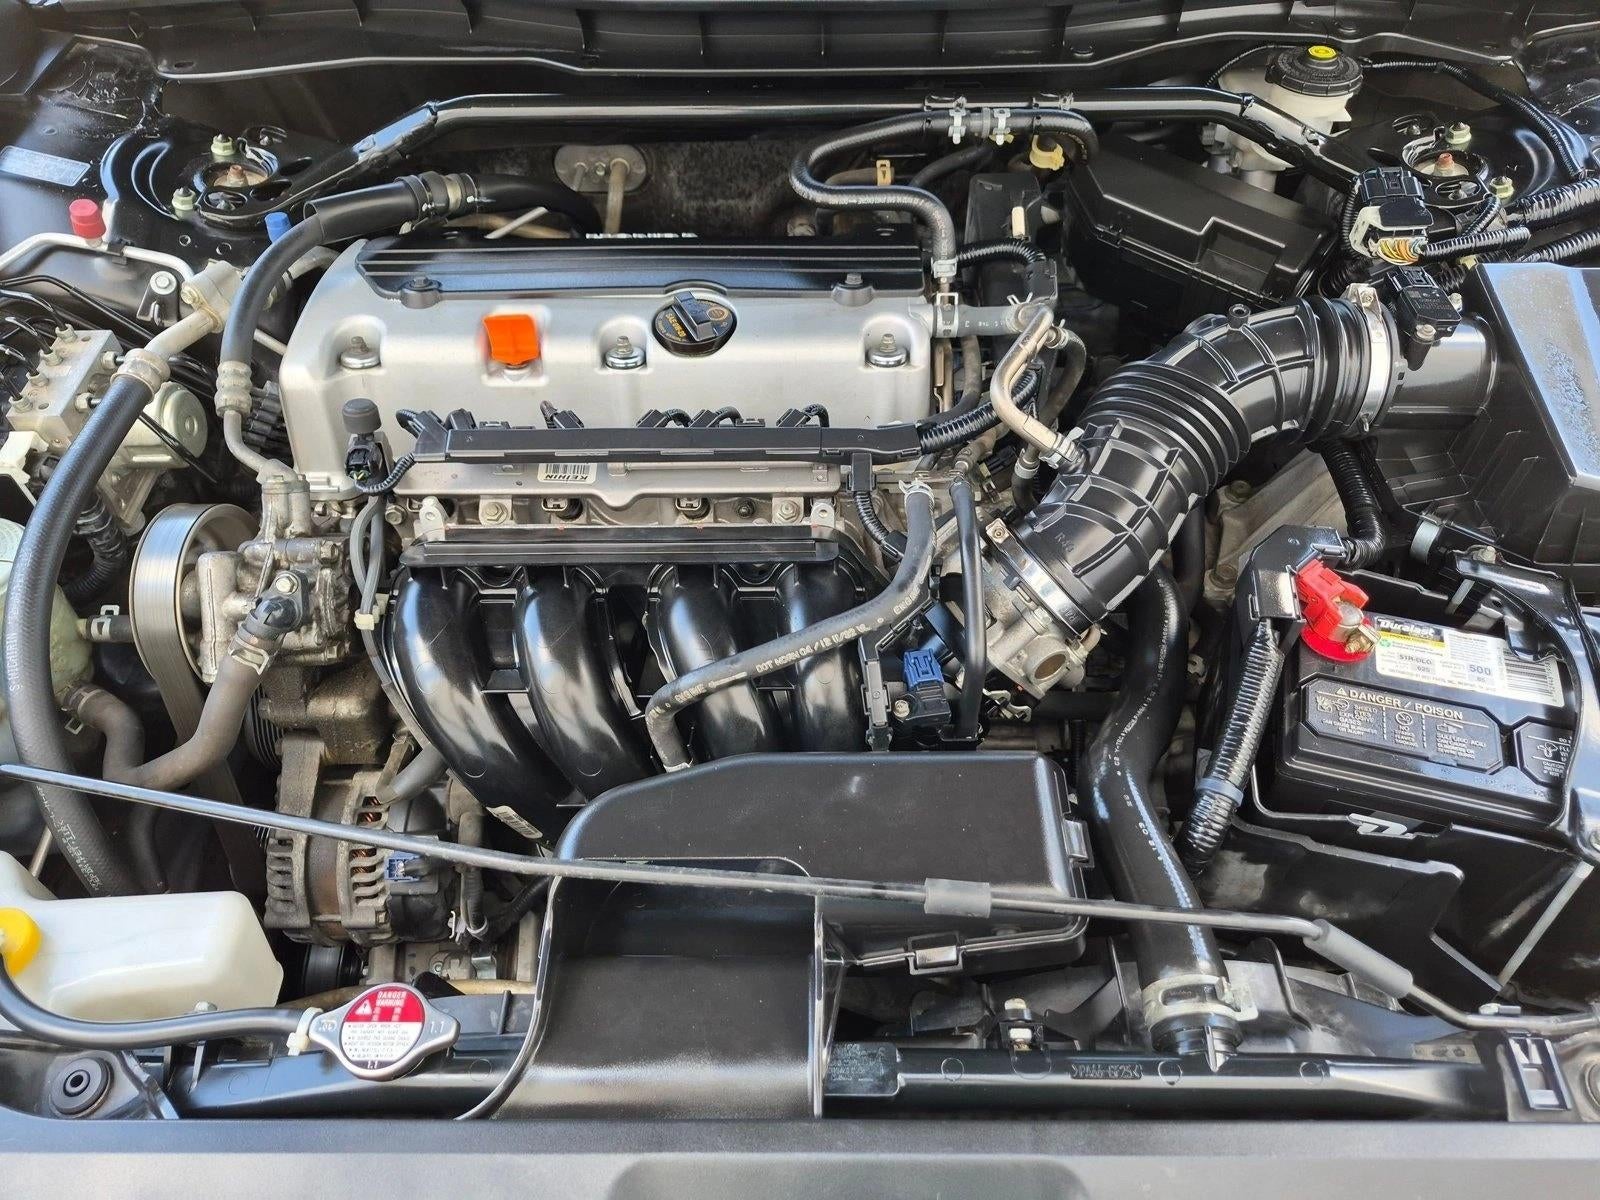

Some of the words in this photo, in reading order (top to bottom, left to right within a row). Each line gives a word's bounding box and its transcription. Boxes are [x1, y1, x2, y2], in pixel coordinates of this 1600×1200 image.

[1377, 617, 1436, 636] Duralast
[1468, 664, 1491, 676] 500
[1349, 689, 1401, 708] DANGER
[1414, 702, 1464, 720] POISON
[377, 991, 408, 999] DANGER
[430, 1020, 444, 1034] 1.1
